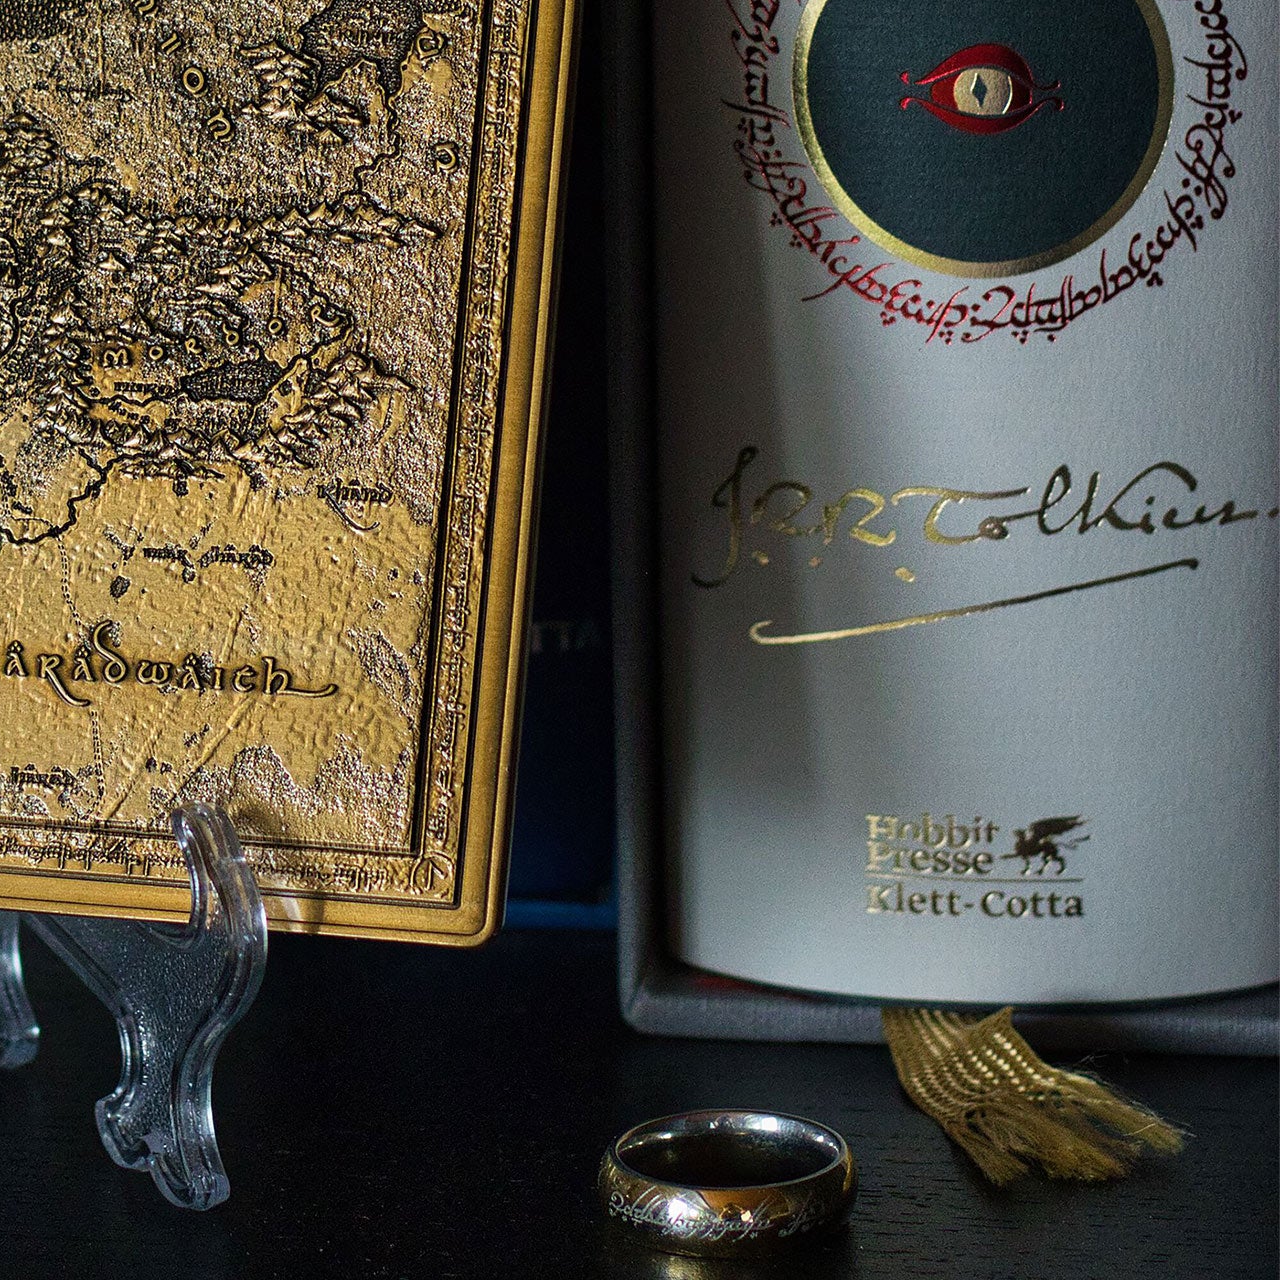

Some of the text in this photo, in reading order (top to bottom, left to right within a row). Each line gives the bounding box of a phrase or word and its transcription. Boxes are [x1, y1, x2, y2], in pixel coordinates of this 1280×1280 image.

[865, 811, 1001, 848] Hobbit
[865, 841, 994, 875] Presse
[866, 882, 1085, 918] Klett-Cotta
